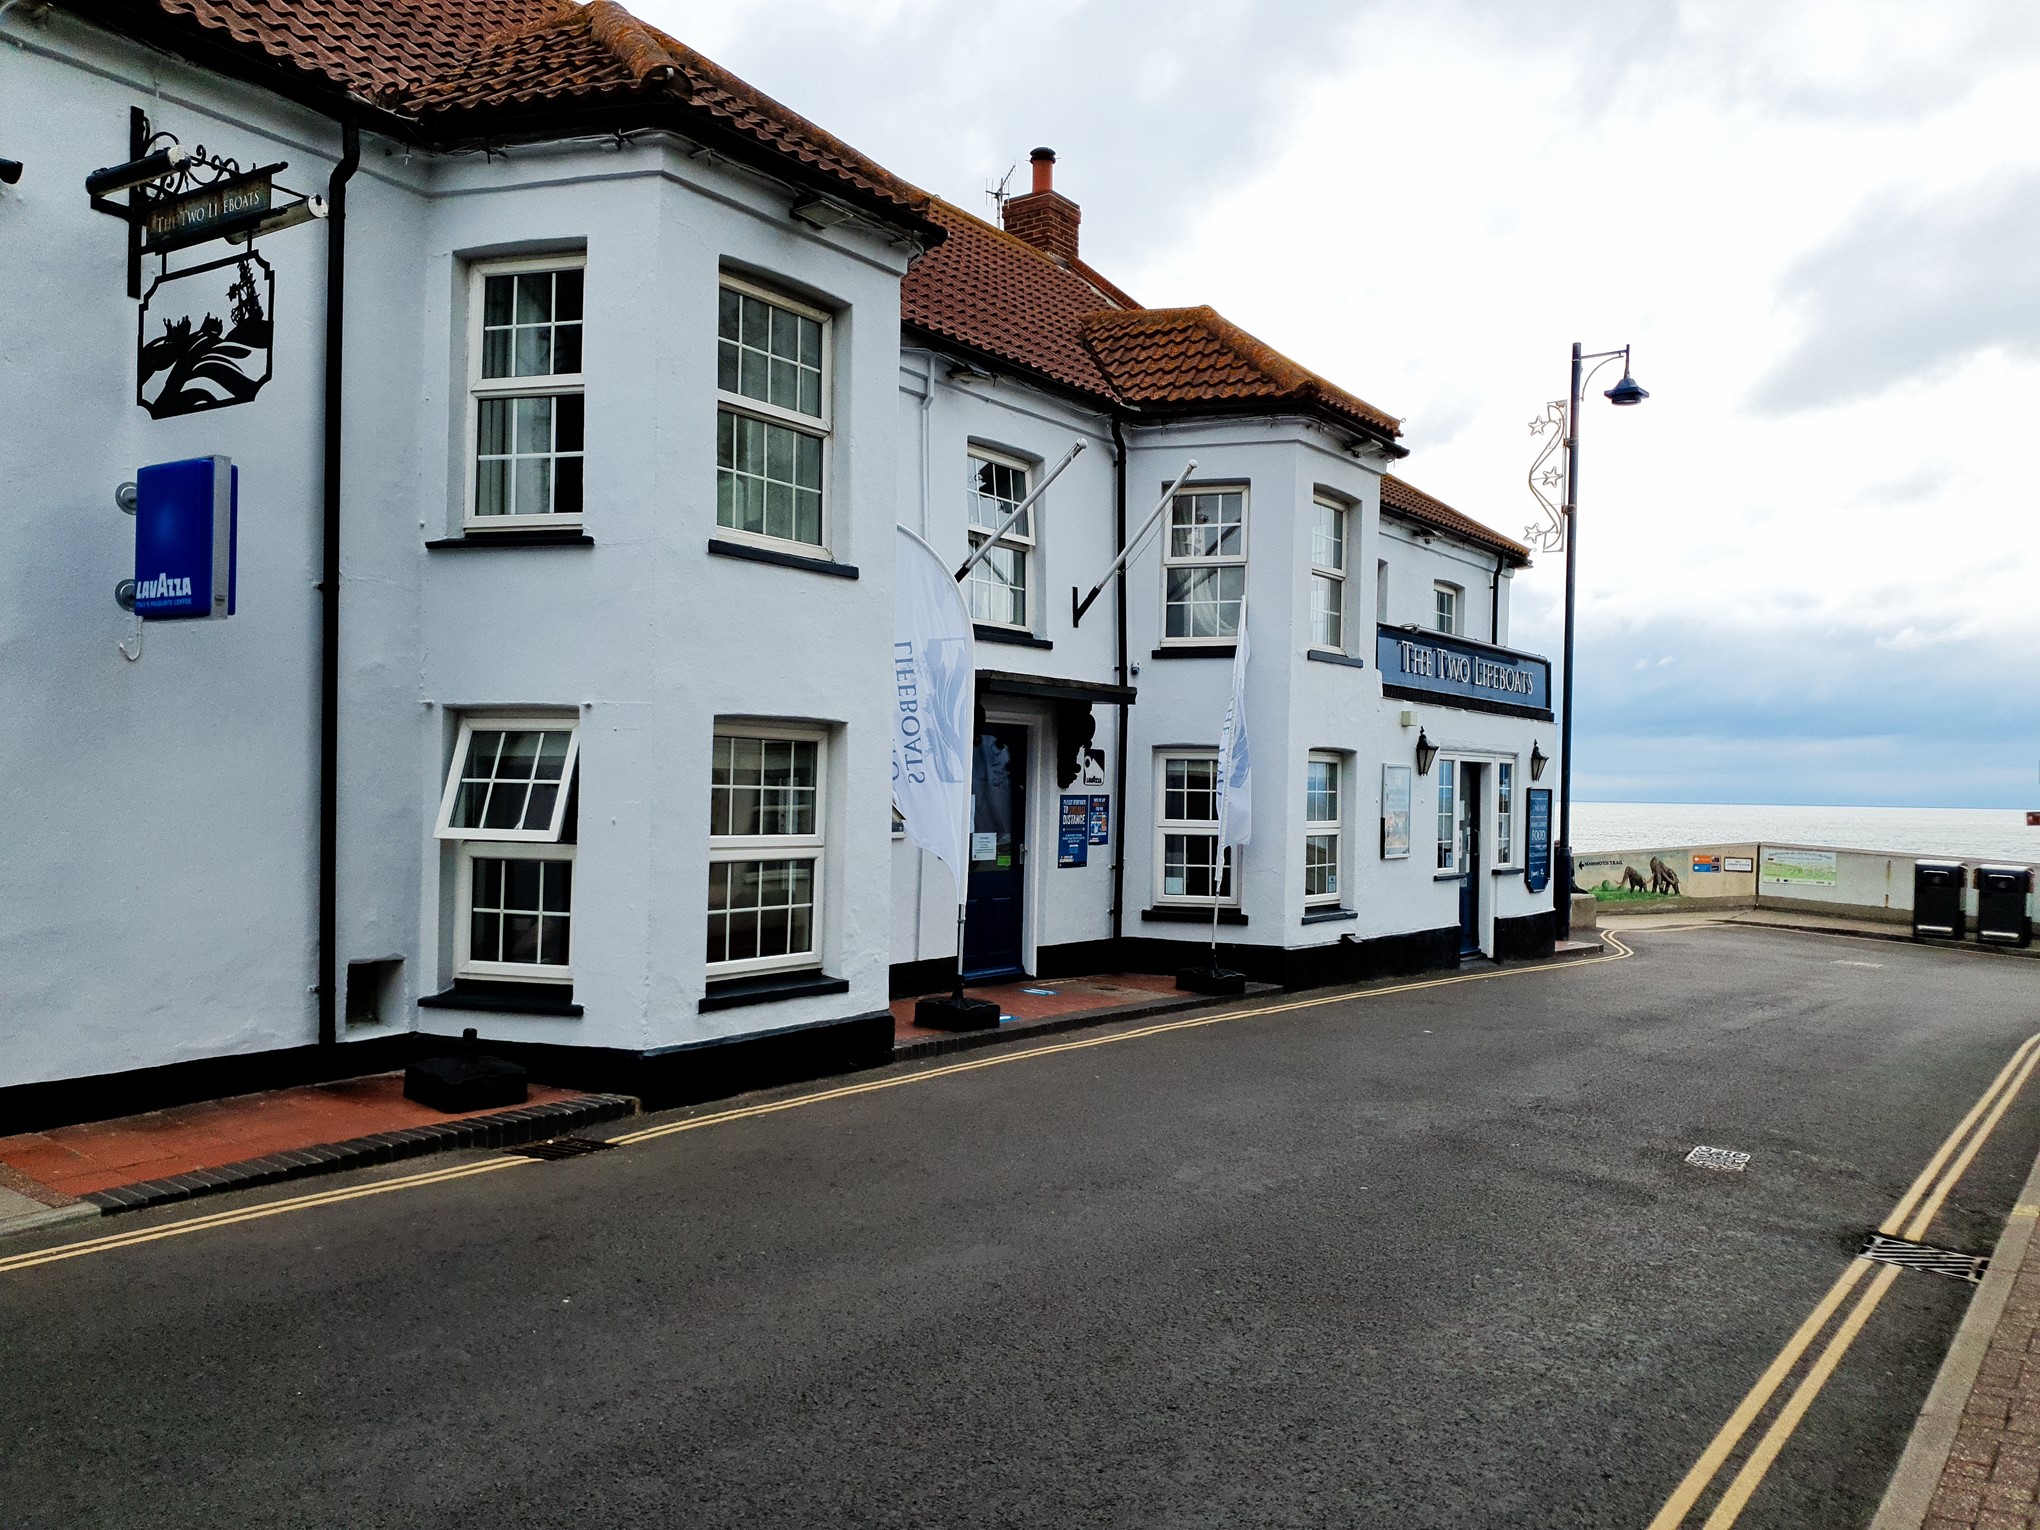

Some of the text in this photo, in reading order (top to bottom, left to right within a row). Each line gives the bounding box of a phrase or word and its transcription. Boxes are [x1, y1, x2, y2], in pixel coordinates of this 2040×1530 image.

[180, 207, 205, 226] TWO
[208, 189, 260, 218] LIEBOATS
[136, 572, 192, 599] LAVAZZA
[1401, 640, 1534, 695] THE TWO LIFEBOATS
[1531, 829, 1546, 840] FOOD
